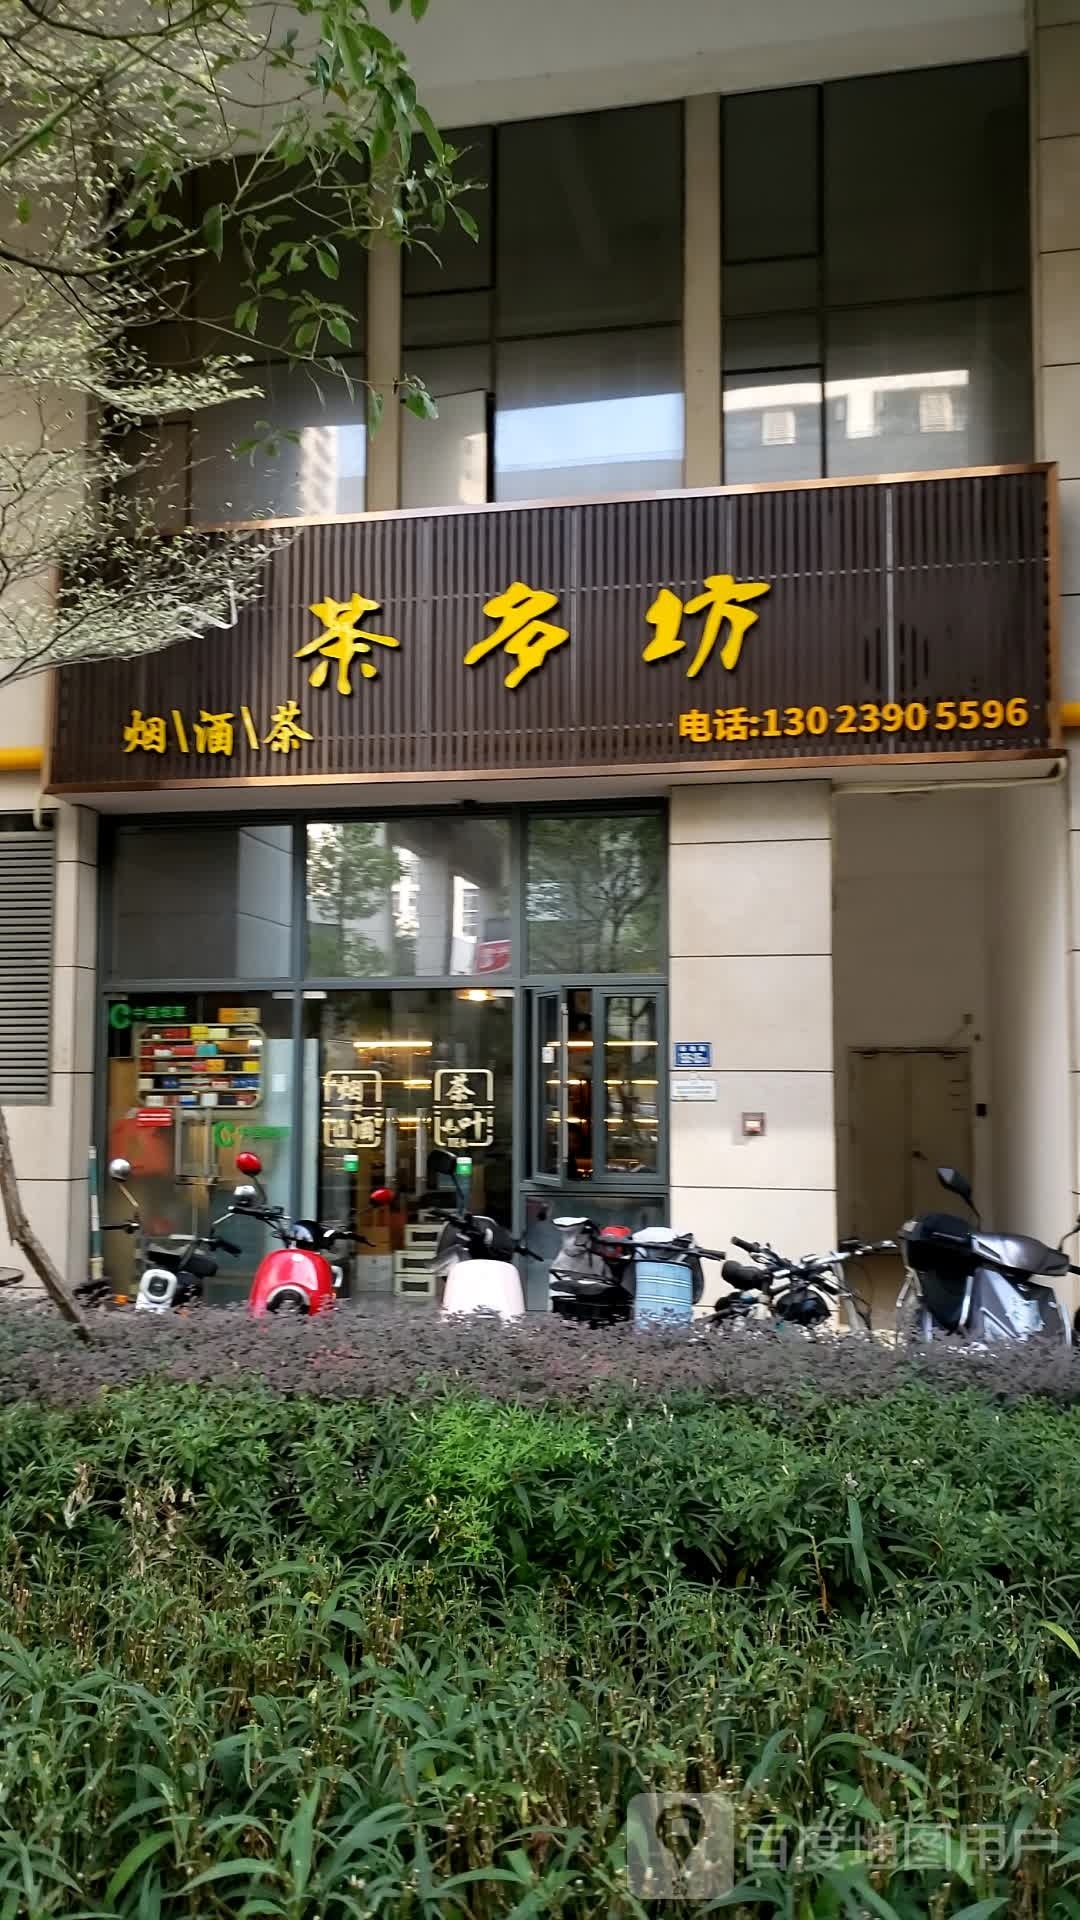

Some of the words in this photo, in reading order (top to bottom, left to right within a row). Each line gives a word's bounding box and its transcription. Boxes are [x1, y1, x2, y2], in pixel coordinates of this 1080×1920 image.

[293, 573, 770, 695] 茶多坊
[835, 702, 927, 733] 2390
[935, 697, 1028, 730] 5596
